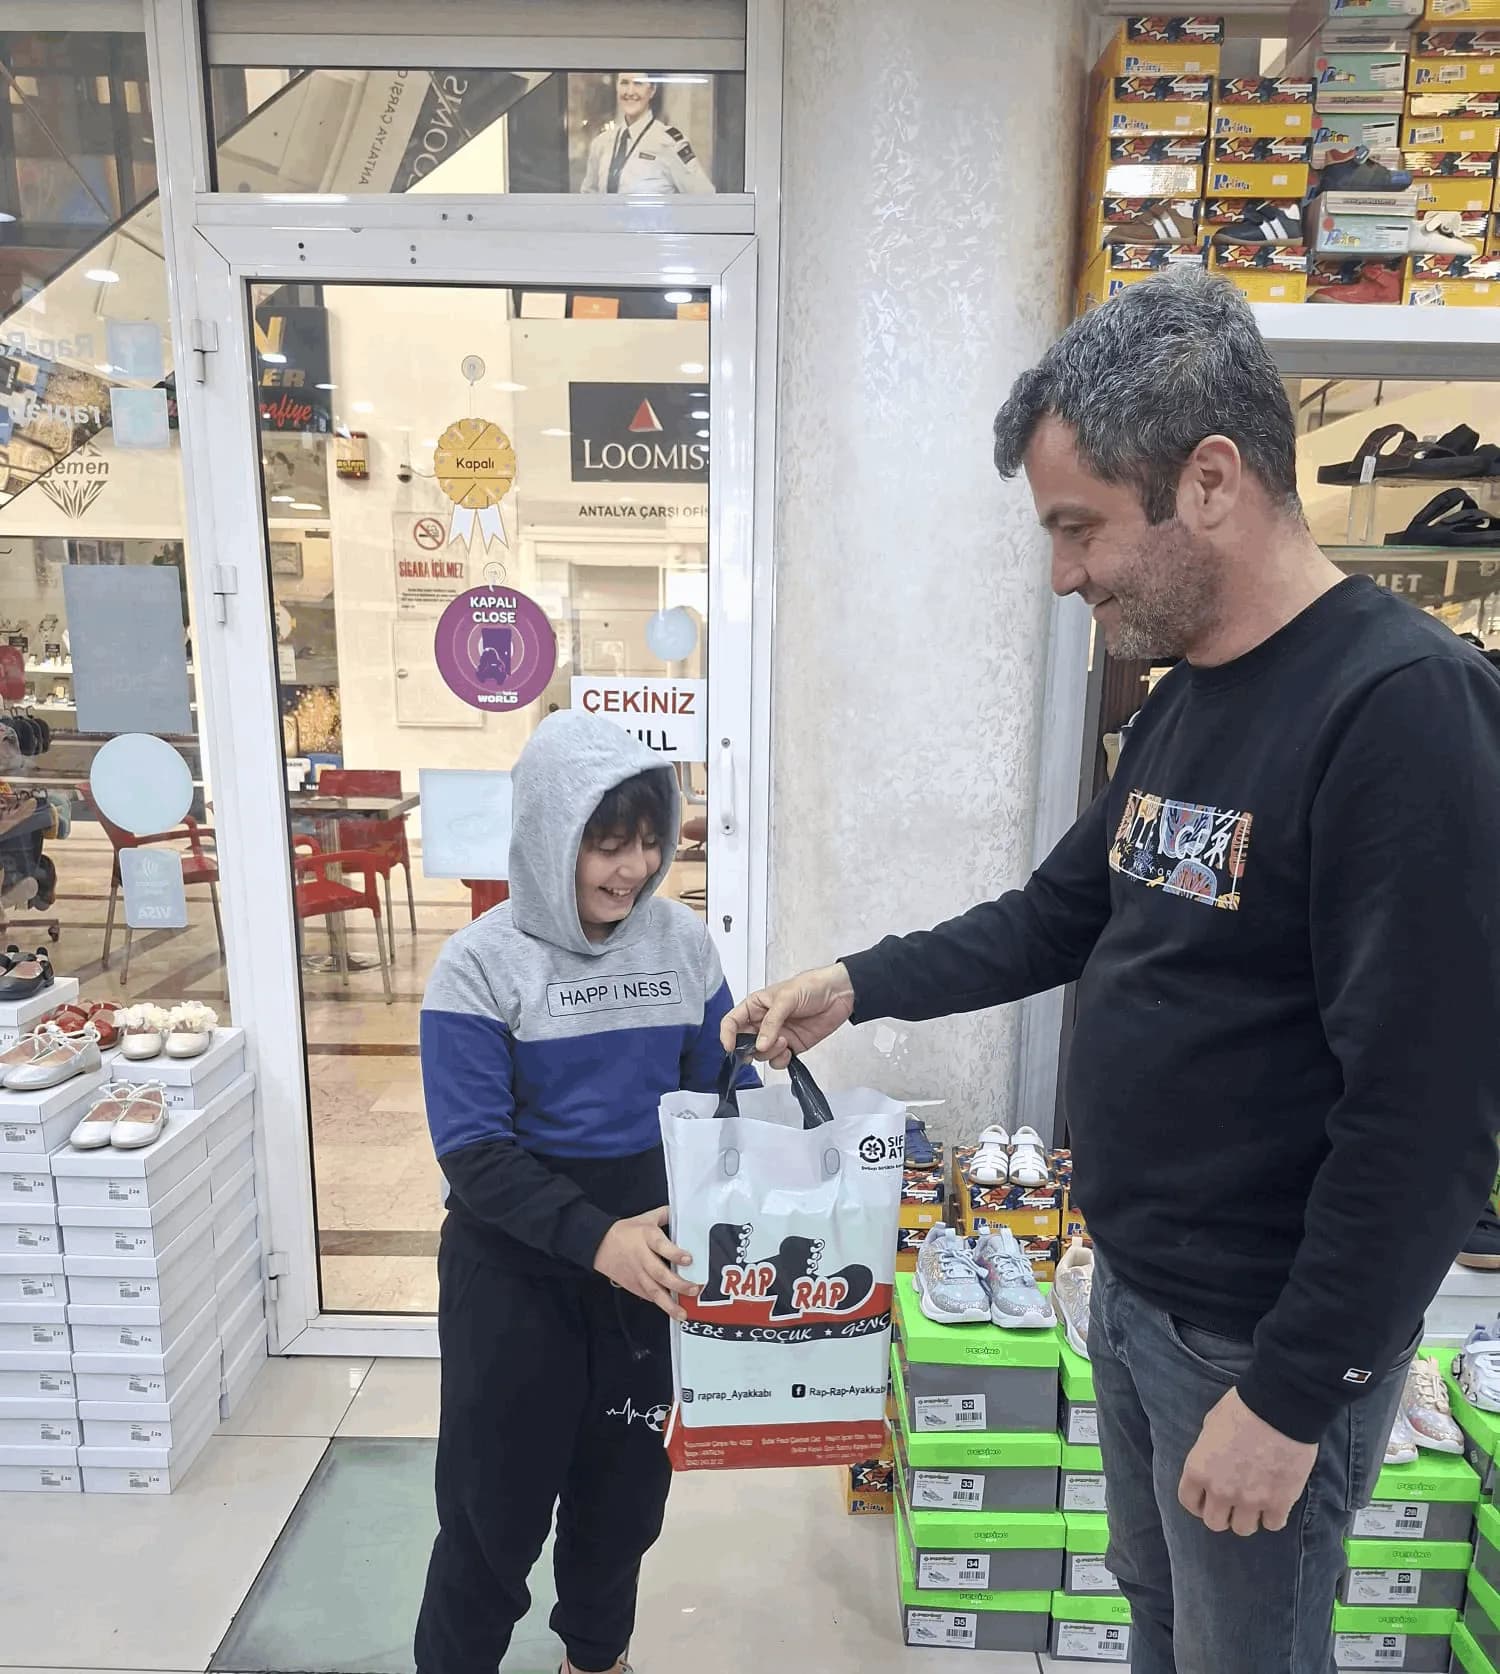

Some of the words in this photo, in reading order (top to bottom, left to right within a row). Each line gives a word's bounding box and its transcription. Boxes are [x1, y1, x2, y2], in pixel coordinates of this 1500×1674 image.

[583, 439, 705, 470] LOOMIS
[456, 457, 495, 472] Kapalı
[578, 505, 637, 517] ANTALYA
[398, 559, 430, 577] SİGARA
[431, 559, 464, 580] İÇİLMEZ
[470, 597, 517, 609] KAPALI
[472, 612, 516, 623] CLOSE
[478, 695, 518, 703] WORLD
[583, 686, 695, 714] ÇEKİNİZ
[724, 1267, 773, 1296] RAP
[795, 1282, 846, 1309] RAP
[749, 1328, 812, 1343] ÇOÇUK
[841, 1313, 890, 1335] GENÇ
[697, 1388, 772, 1401] raprap_Ayakkabı
[962, 1400, 974, 1409] 32
[961, 1480, 973, 1489] 33
[967, 1559, 978, 1568] 34
[954, 1617, 966, 1626] 35
